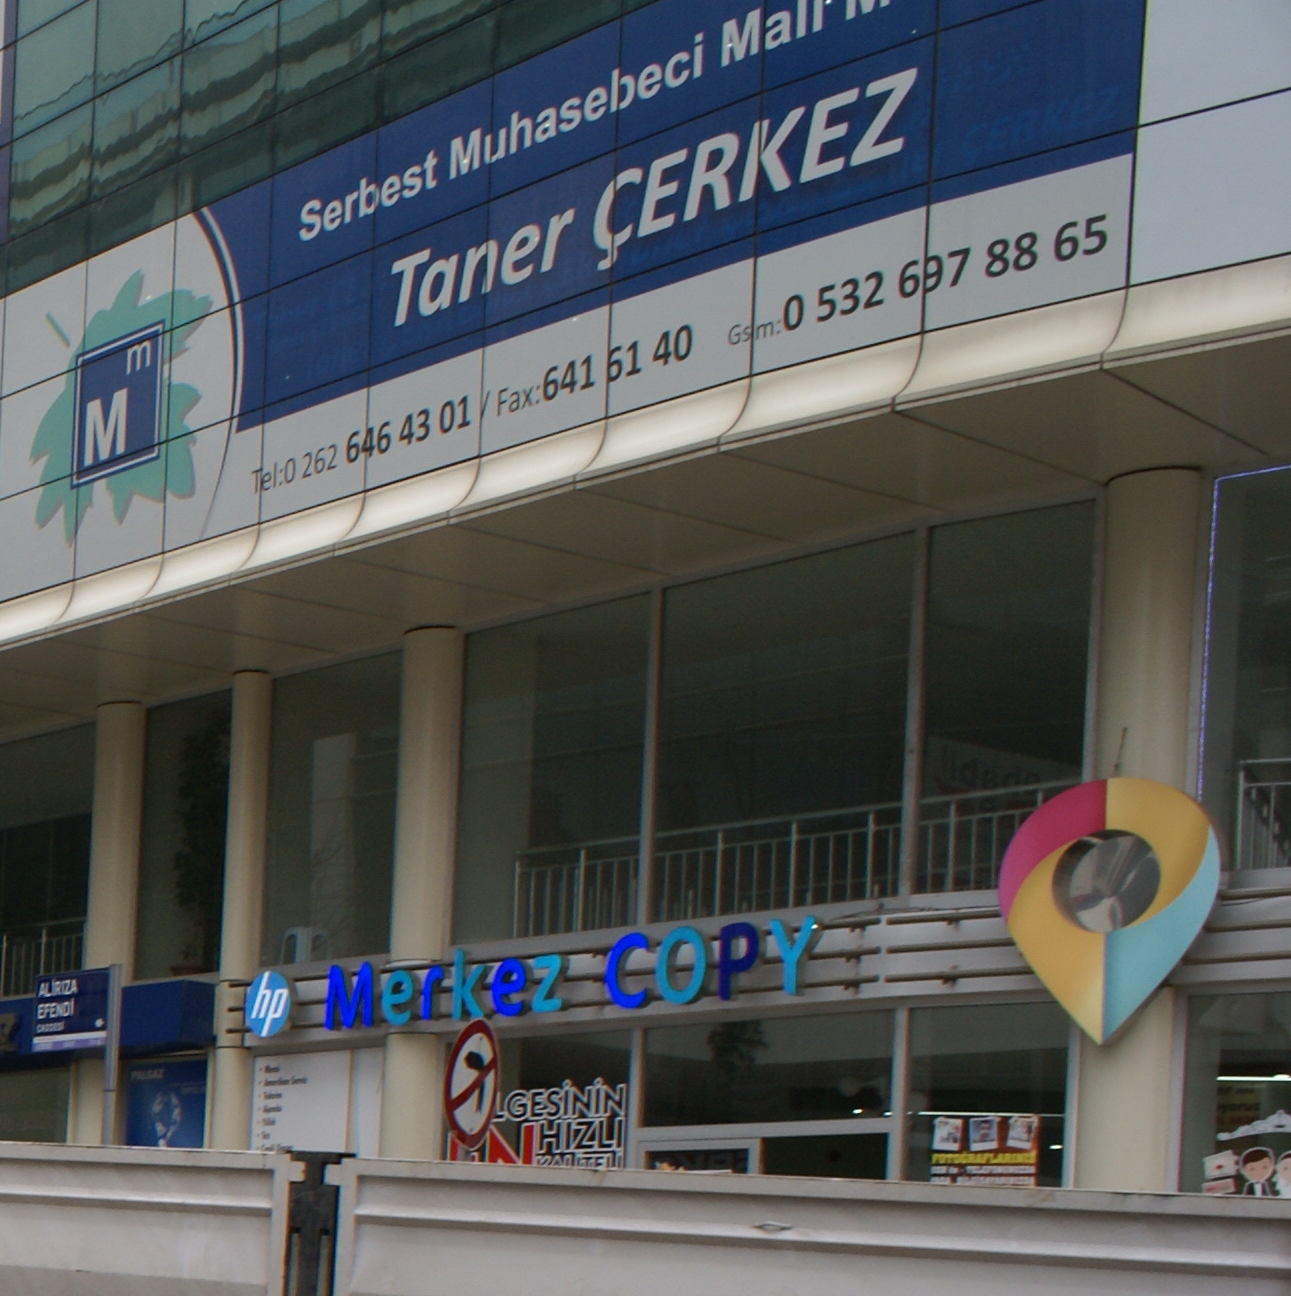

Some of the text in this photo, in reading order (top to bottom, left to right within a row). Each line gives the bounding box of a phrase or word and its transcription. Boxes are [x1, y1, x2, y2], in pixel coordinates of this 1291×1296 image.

[299, 150, 438, 242] Serbest
[448, 31, 705, 180] Muhasebeci
[390, 66, 919, 327] Taner ÇERKEZ
[301, 443, 338, 479] 262
[345, 420, 392, 464] 646
[399, 408, 431, 446] 43
[439, 395, 472, 436] 01
[607, 338, 642, 384] 61
[653, 324, 693, 366] 40
[817, 270, 884, 323] 532
[897, 248, 971, 299] 697
[985, 232, 1038, 278] 88
[1054, 214, 1109, 261] 65
[37, 998, 75, 1019] EFENDİ
[251, 970, 289, 1037] hp
[323, 914, 820, 1031] Merkez COPY
[491, 1077, 627, 1123] LGESİNİN
